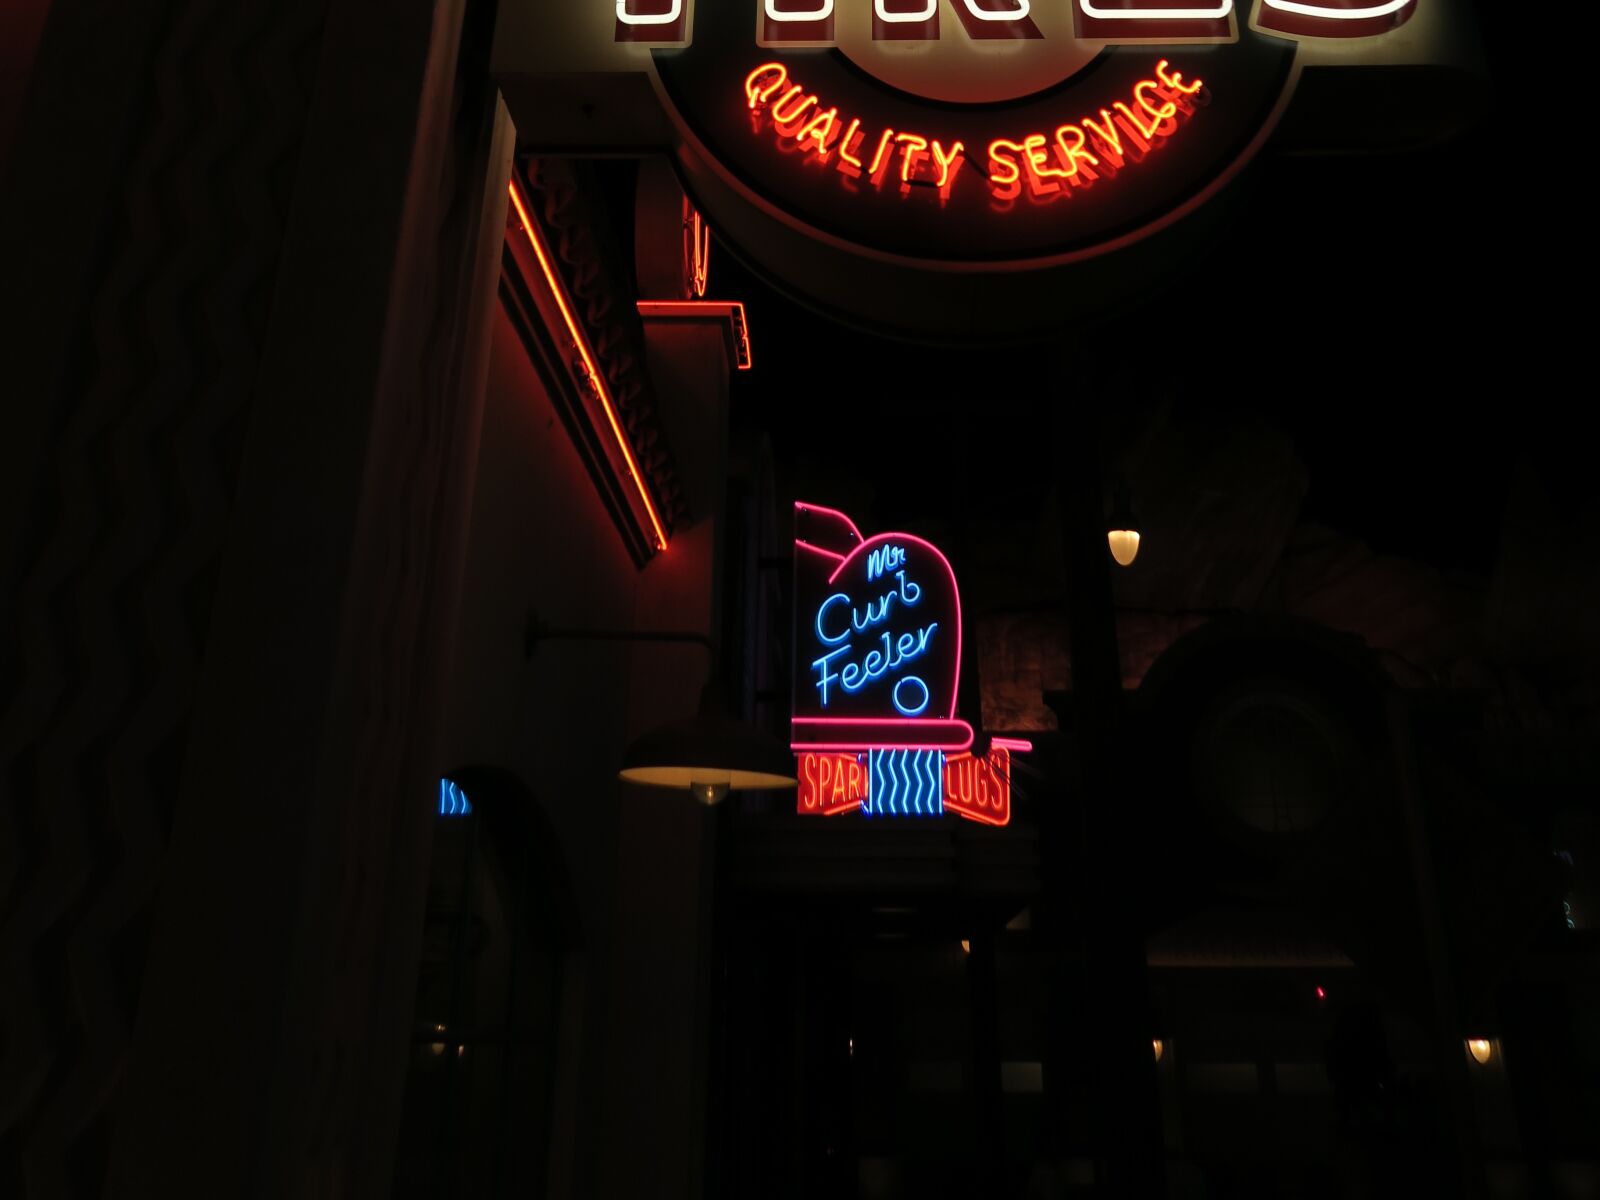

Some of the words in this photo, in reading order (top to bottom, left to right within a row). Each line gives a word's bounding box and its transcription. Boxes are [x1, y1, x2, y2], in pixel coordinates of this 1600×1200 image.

[745, 62, 964, 189] QUALITY
[990, 60, 1203, 186] SERVICE
[867, 544, 906, 582] Mr
[816, 570, 920, 643] Curb
[811, 622, 938, 705] Feeler
[947, 756, 1003, 810] LUGS
